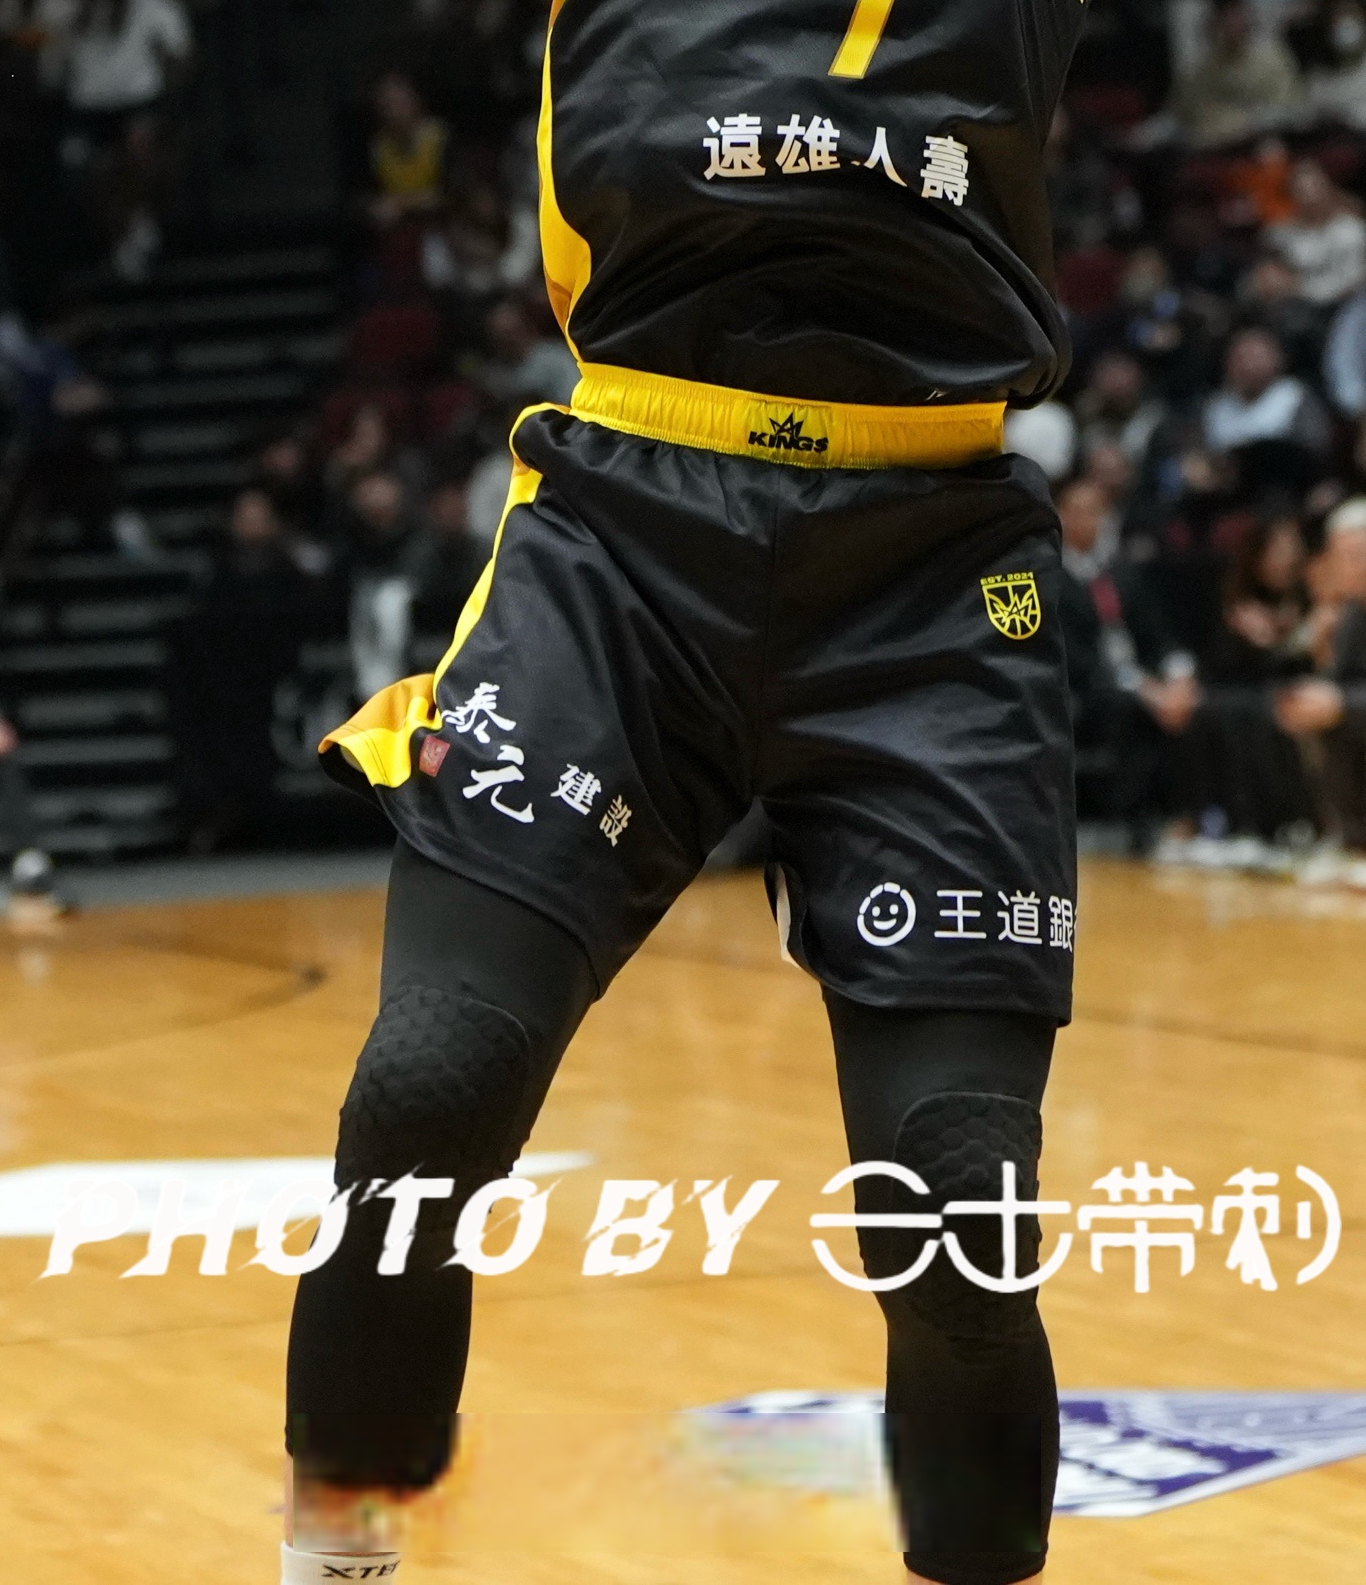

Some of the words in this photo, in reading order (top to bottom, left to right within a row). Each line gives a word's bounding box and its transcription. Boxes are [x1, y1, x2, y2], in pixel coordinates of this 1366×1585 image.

[703, 113, 970, 207] 遠雄人壽
[748, 430, 830, 453] KINGS
[934, 889, 1078, 953] 王道銀
